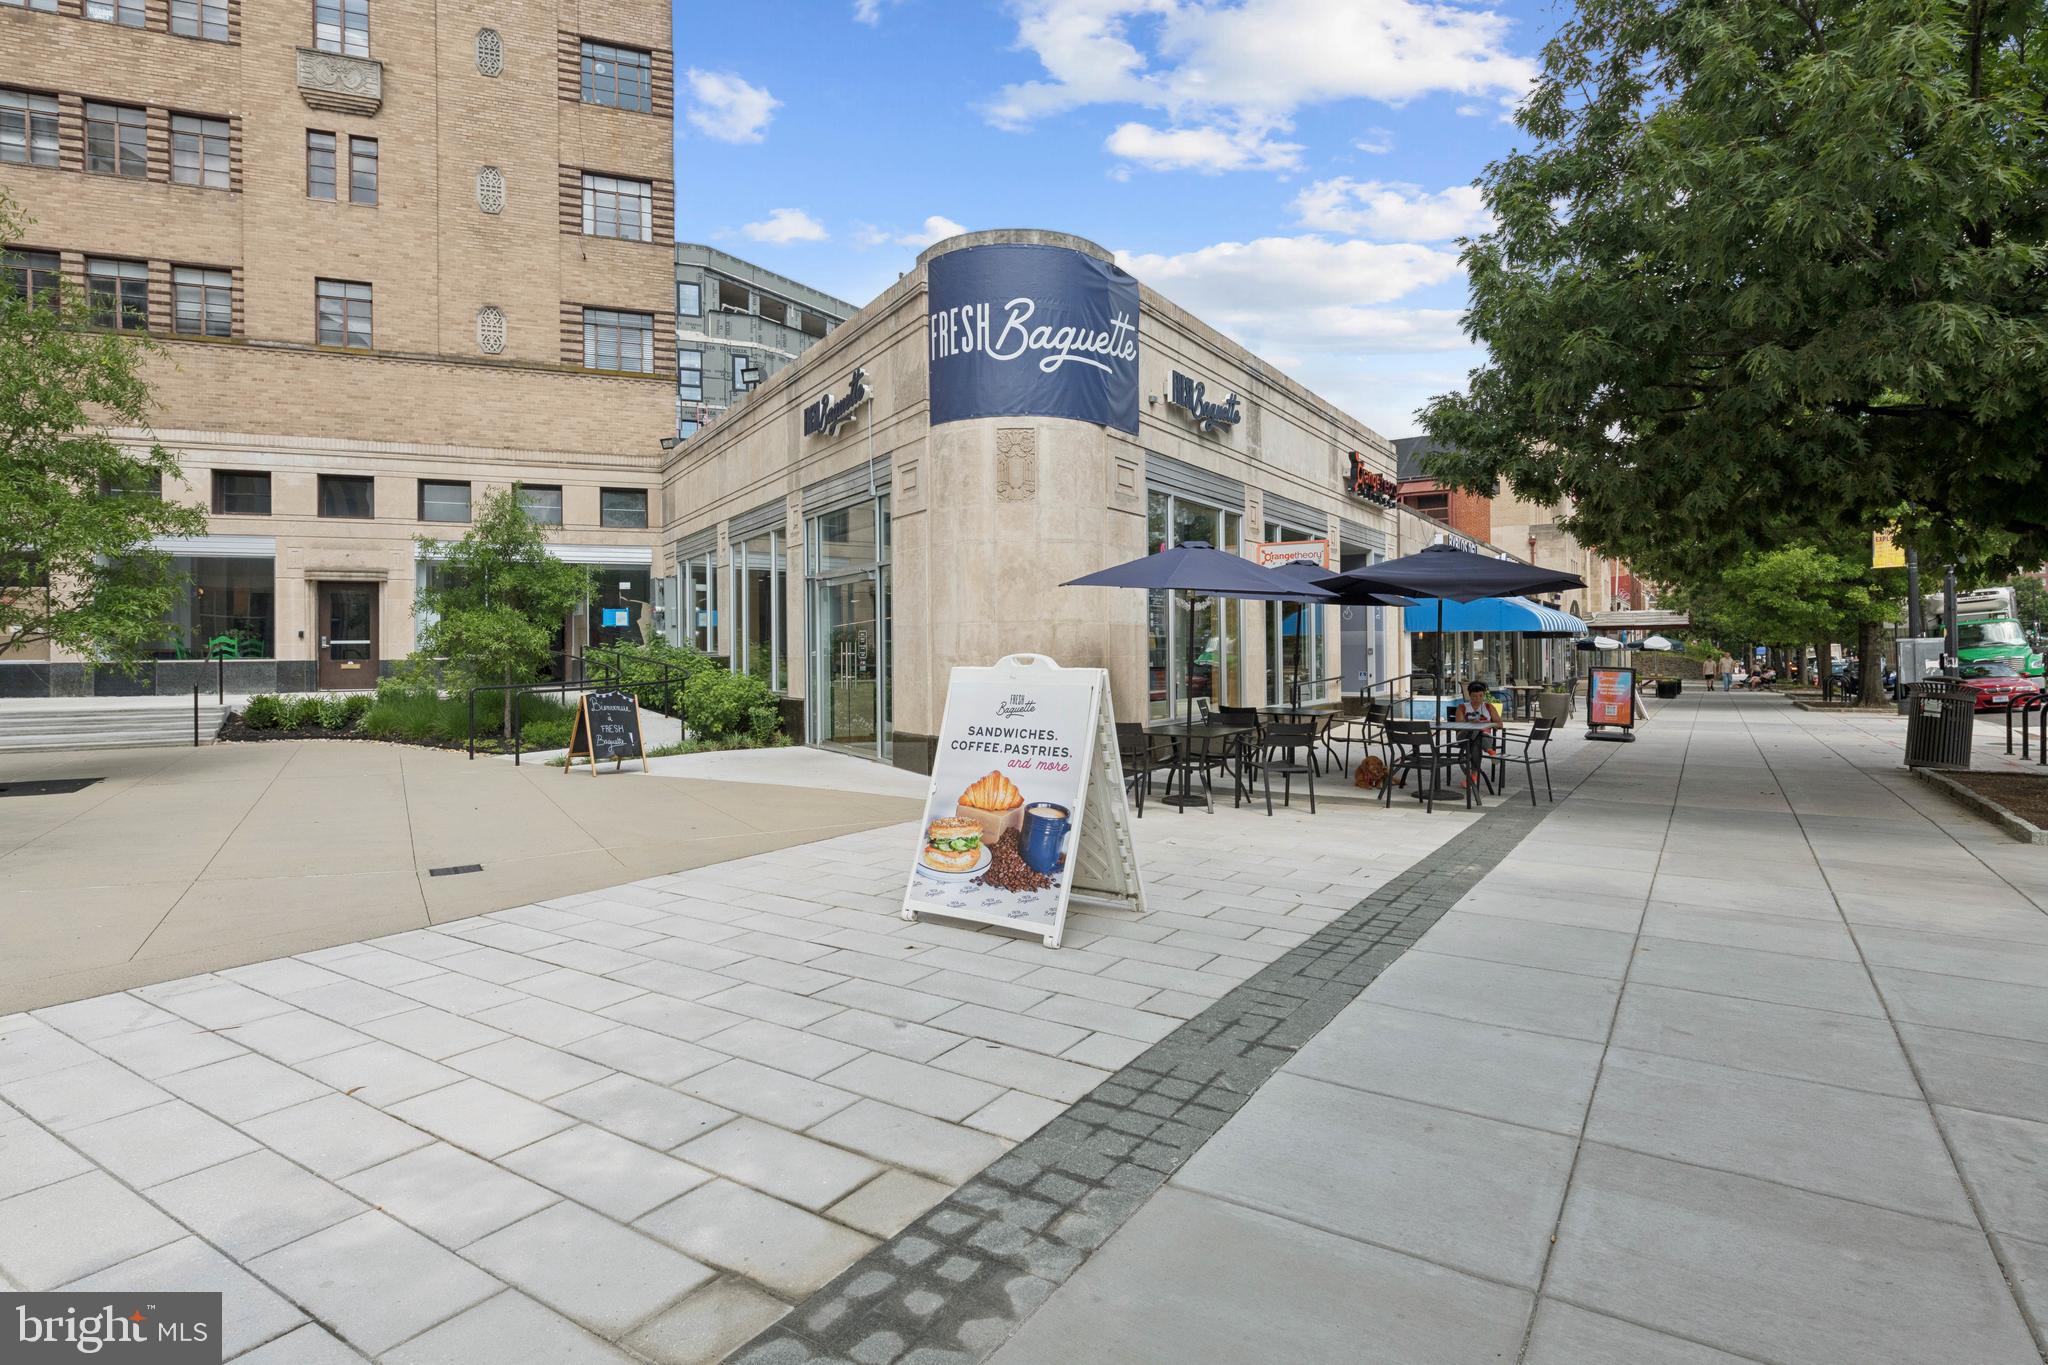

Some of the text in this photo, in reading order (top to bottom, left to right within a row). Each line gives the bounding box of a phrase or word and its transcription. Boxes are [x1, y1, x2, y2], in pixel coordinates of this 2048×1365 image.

[931, 297, 1137, 374] FRESH Baguette
[995, 699, 1036, 719] Baguette
[600, 724, 625, 733] FRESH
[967, 726, 1058, 741] SANDWICHES.
[1007, 758, 1070, 772] and more
